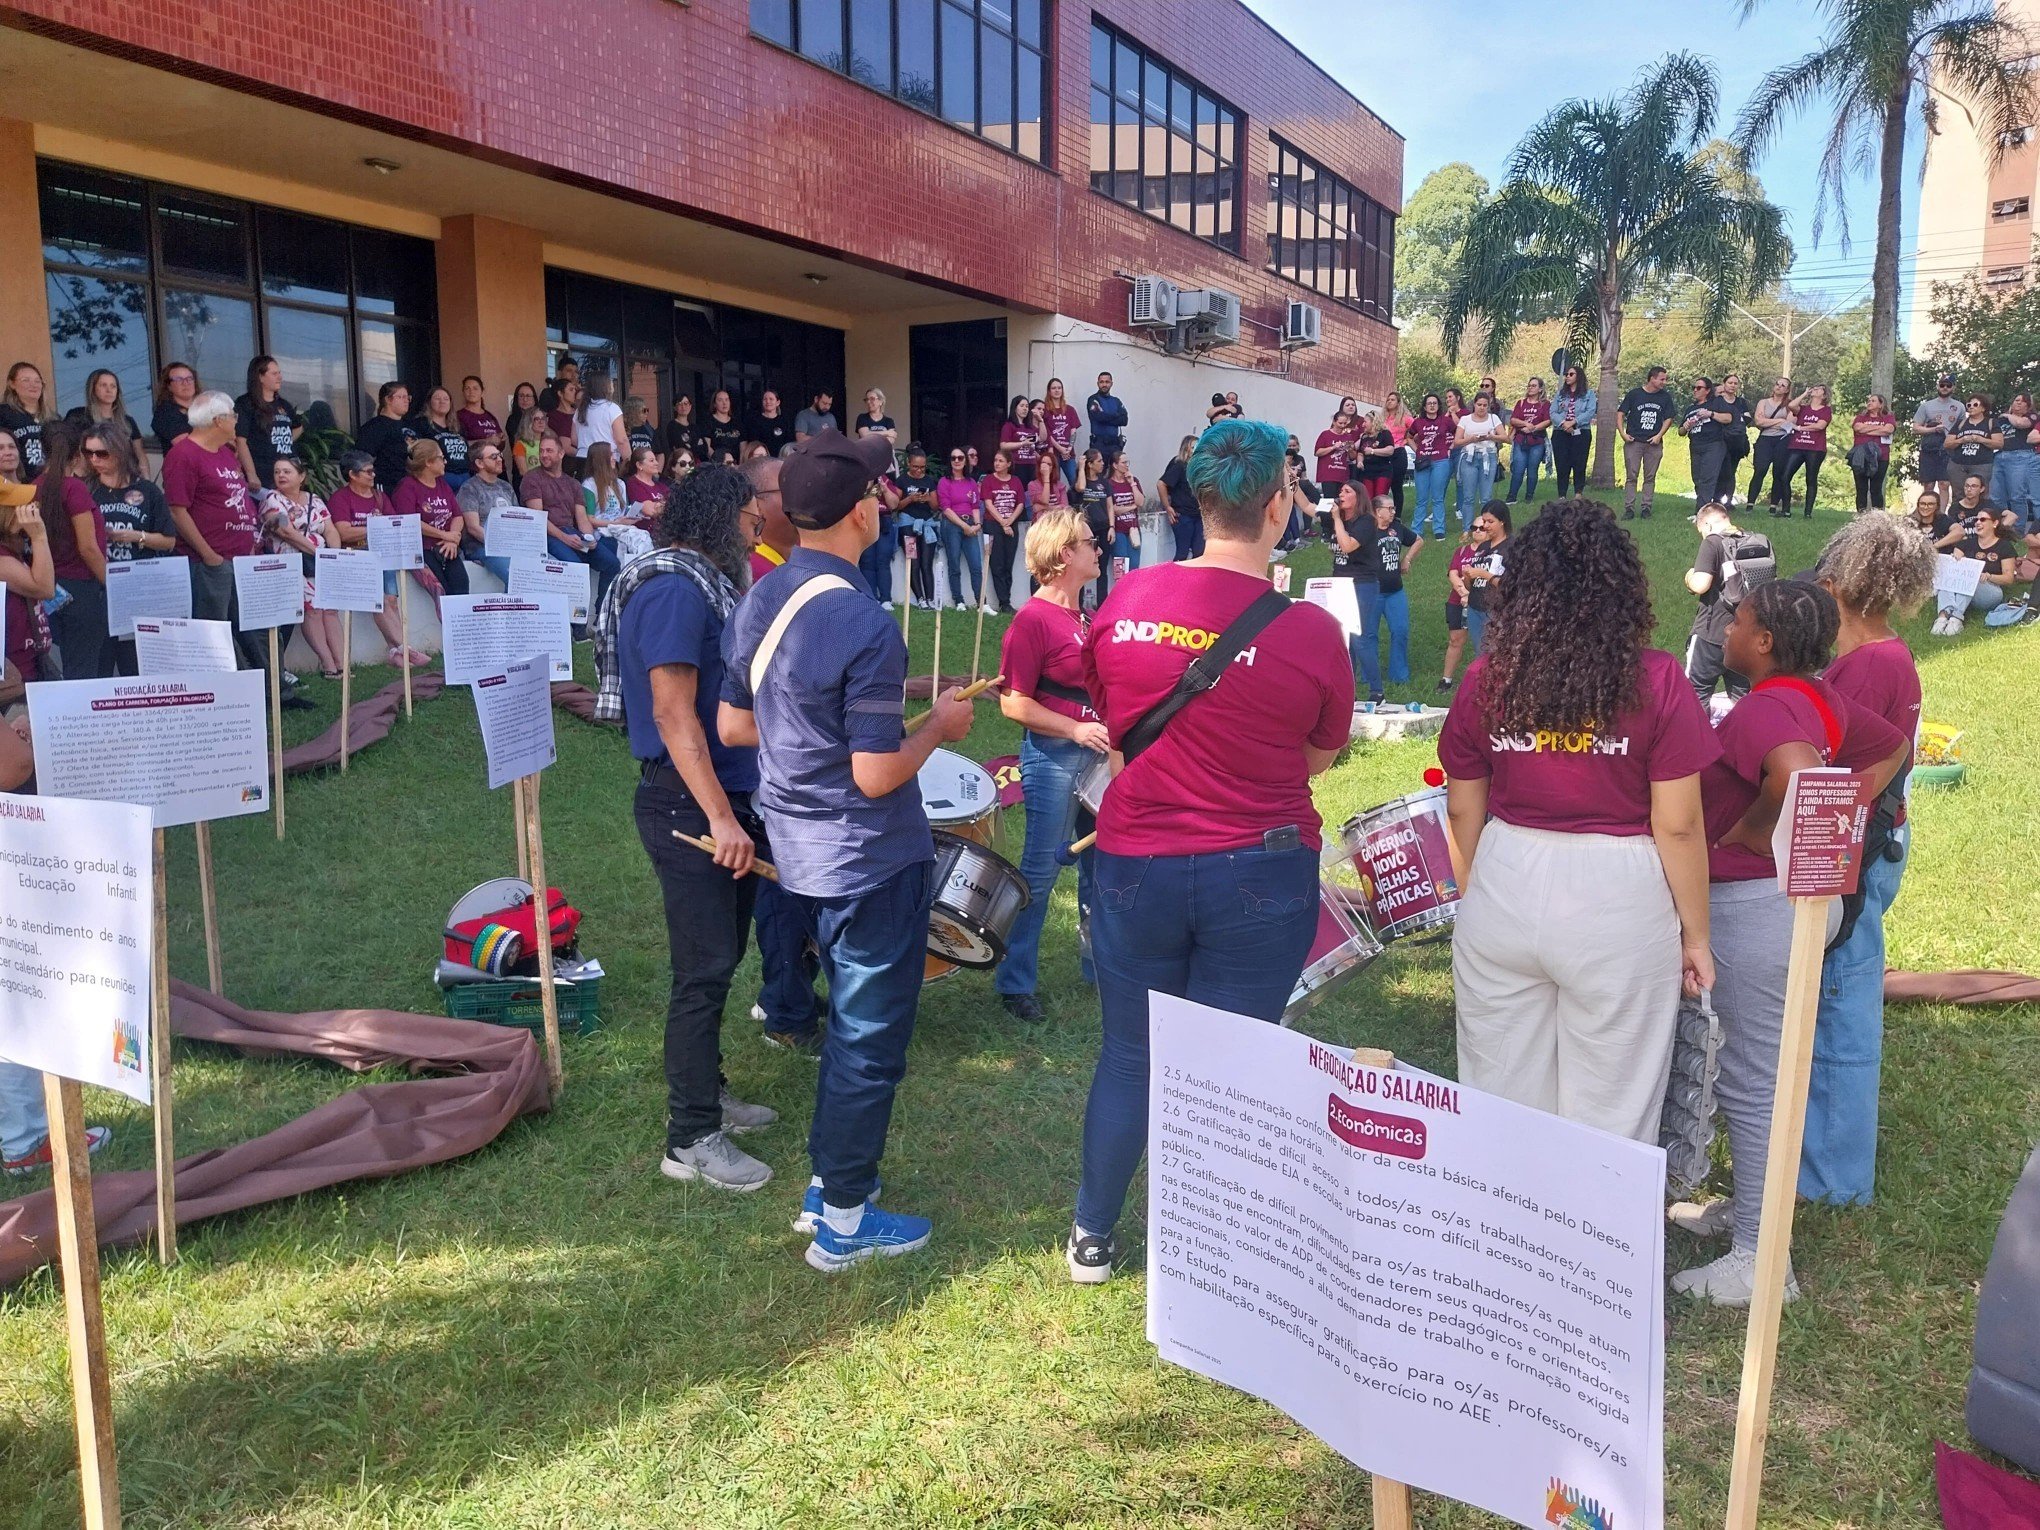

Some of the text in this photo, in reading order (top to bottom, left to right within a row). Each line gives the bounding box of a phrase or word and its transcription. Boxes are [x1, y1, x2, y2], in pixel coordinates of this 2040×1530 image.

[158, 683, 188, 694] SALARIAL
[1824, 797, 1854, 805] ESTAMOS
[1361, 828, 1415, 862] GOVERNO
[1373, 850, 1408, 875] NOVO
[18, 872, 76, 895] Educação
[74, 858, 120, 875] gradual
[122, 862, 138, 878] das
[1374, 866, 1420, 896] VELHAS
[1376, 881, 1432, 915] PRÁTICAS
[6, 914, 137, 949] do atendimento de anos
[14, 959, 64, 982] calendário
[70, 972, 96, 986] para
[100, 975, 136, 996] reuniões
[1382, 1074, 1461, 1115] SALARIAL
[1163, 1083, 1325, 1159] independente de carga horária.
[1161, 1136, 1206, 1167] público.
[1164, 1065, 1634, 1258] 2.5 Auxílio Alimentação conforme valor da cesta básica aferida pelo Dieese,
[1163, 1100, 1181, 1117] 2.6
[1186, 1108, 1251, 1142] Gratificação
[1257, 1136, 1273, 1153] de
[1279, 1147, 1307, 1166] difícil
[1313, 1163, 1339, 1188] acesso
[1357, 1189, 1422, 1216] todos/as
[1431, 1209, 1471, 1234] os/as
[1480, 1221, 1597, 1281] trabalhadores/as
[1605, 1279, 1633, 1298] que
[1161, 1120, 1194, 1142] atuam
[1198, 1134, 1210, 1146] na
[1213, 1136, 1279, 1174] modalidade
[1281, 1162, 1300, 1183] EJA
[1313, 1184, 1343, 1211] escolas
[1345, 1204, 1398, 1231] urbanas
[1402, 1223, 1436, 1239] com
[1441, 1228, 1481, 1255] difícil
[1485, 1243, 1533, 1272] acesso
[1538, 1267, 1555, 1282] ao
[1560, 1275, 1632, 1320] transporte
[1160, 1225, 1184, 1246] para
[1194, 1236, 1234, 1265] função.
[1161, 1153, 1631, 1363] 2.7 Gratificação de difícil provimento para os/as trabalhadores/as que atuam
[1162, 1174, 1611, 1374] nas escolas que encontram, dificuldades de terem seus quadros completos.
[1159, 1263, 1187, 1285] com
[1189, 1273, 1255, 1310] habilitação
[1257, 1311, 1316, 1346] específica
[1318, 1341, 1341, 1366] para
[1353, 1367, 1428, 1404] exercício
[1433, 1396, 1455, 1411] no
[1458, 1401, 1492, 1424] AEE
[1160, 1240, 1627, 1467] 2.9 Estudo para assegurar gratificação para os/as professores/as
